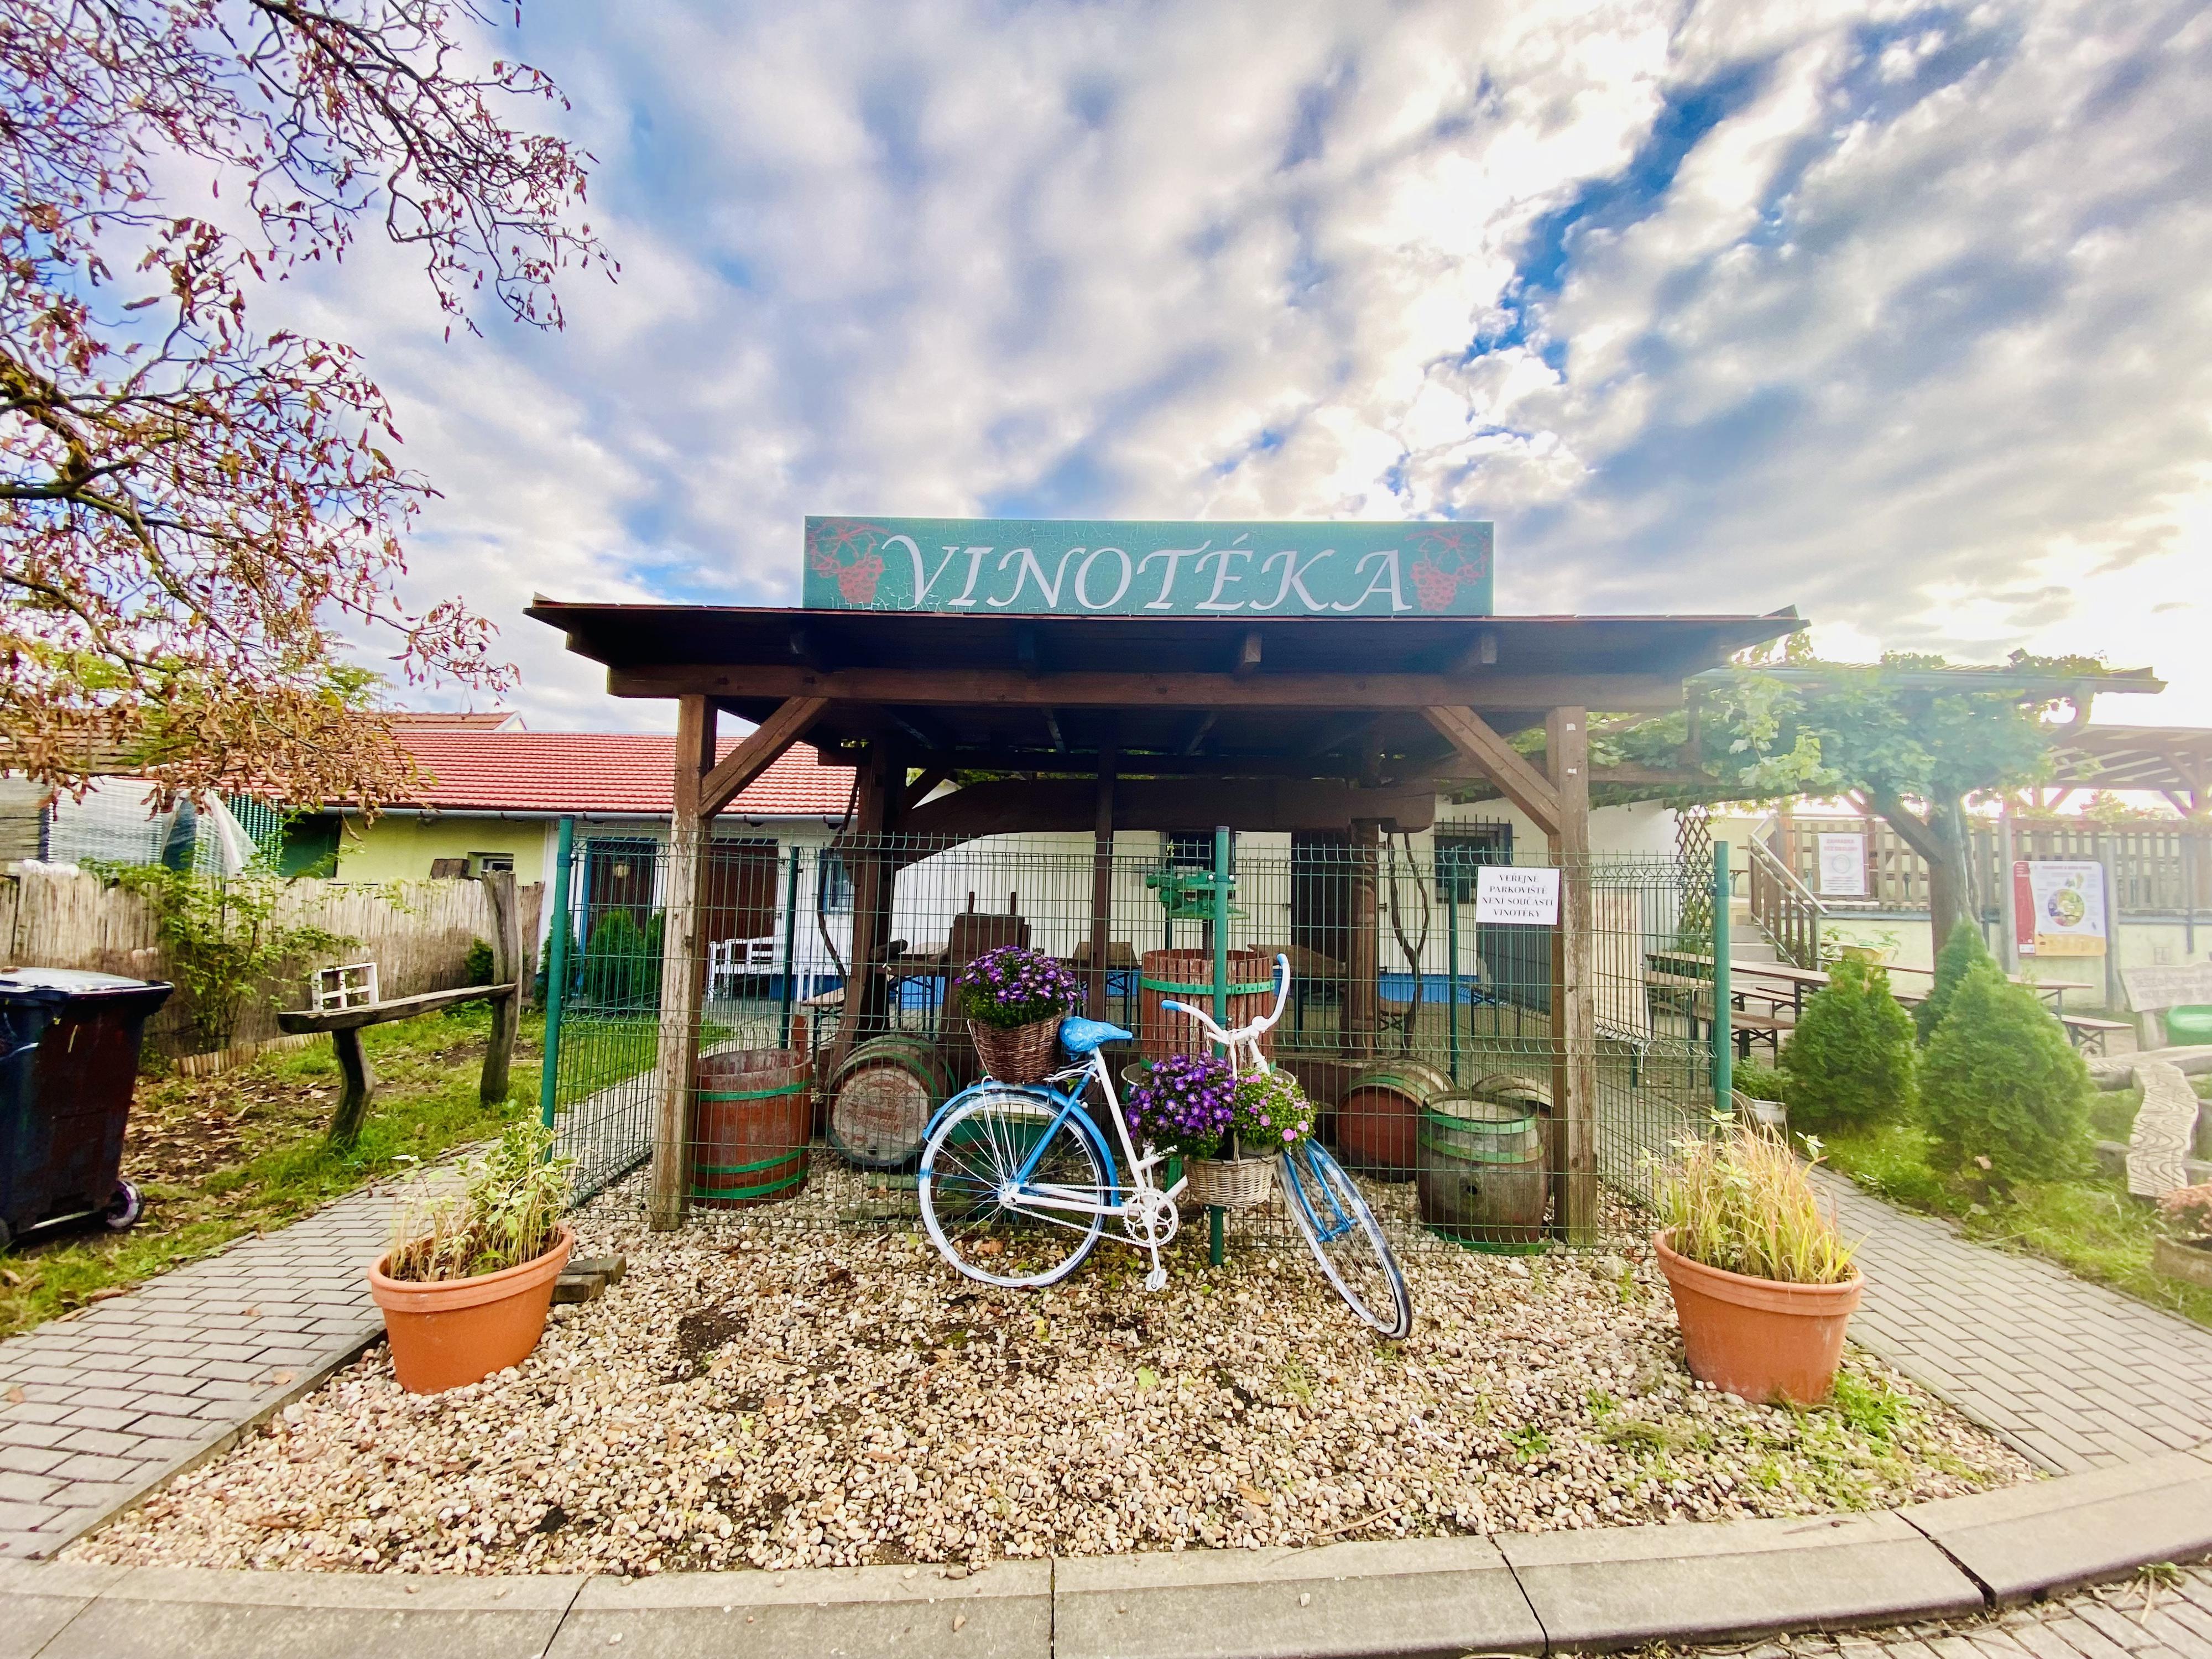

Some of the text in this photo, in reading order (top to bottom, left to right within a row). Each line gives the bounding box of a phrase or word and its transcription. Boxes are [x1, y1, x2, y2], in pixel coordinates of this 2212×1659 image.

[881, 533, 1412, 612] VINOTÉKA
[1499, 873, 1539, 884] VEŘEJNÉ
[1490, 885, 1547, 895] PARKOVIŠTĚ
[1482, 896, 1504, 905] NENÍ
[1494, 907, 1541, 917] VINOTÉKY
